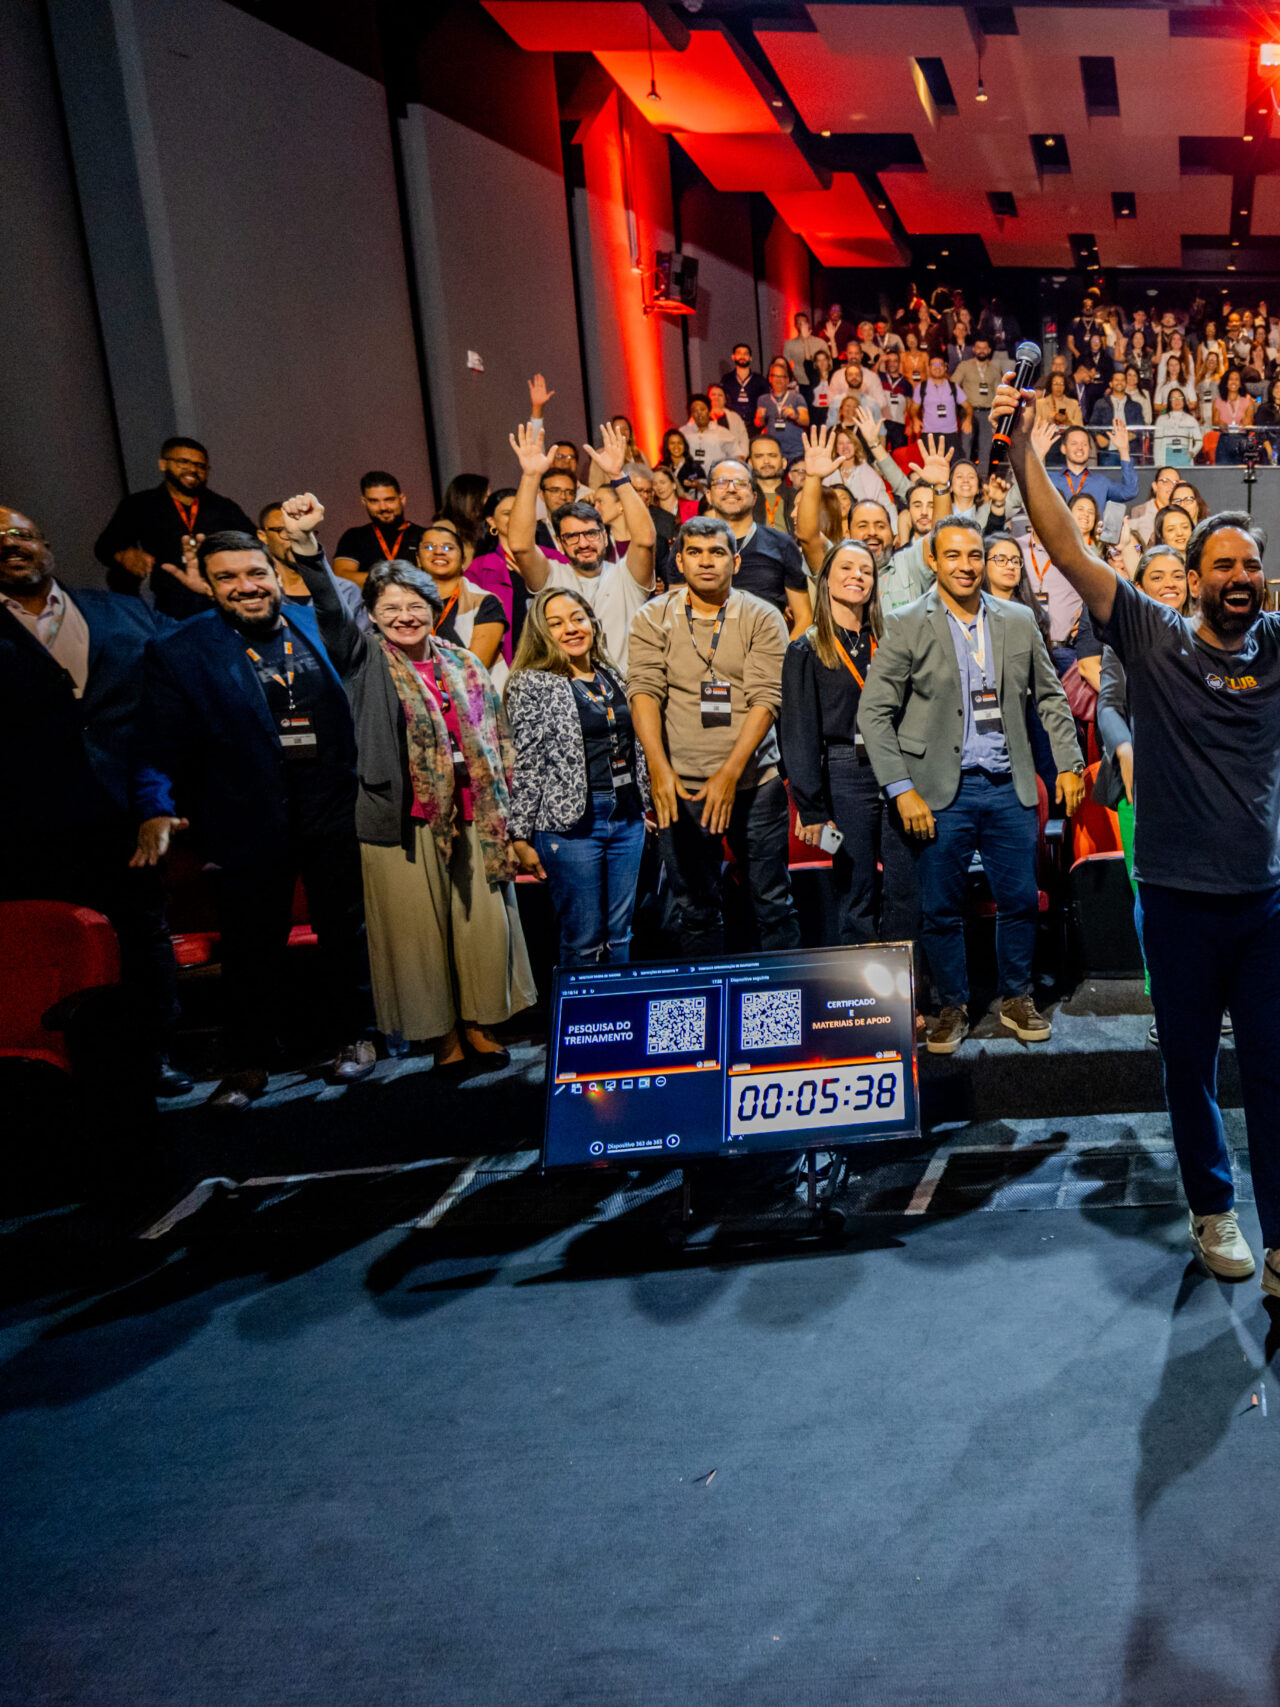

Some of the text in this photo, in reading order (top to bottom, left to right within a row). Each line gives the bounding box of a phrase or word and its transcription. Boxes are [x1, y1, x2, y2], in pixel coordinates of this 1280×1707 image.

[826, 998, 876, 1009] CERTIFICADO
[848, 1009, 855, 1017] E
[568, 1021, 631, 1034] PESQUISA DO
[812, 1016, 892, 1030] MATERIAIS DE APOIO
[564, 1031, 634, 1045] TREINAMENTO
[737, 1072, 898, 1121] 00:05:38
